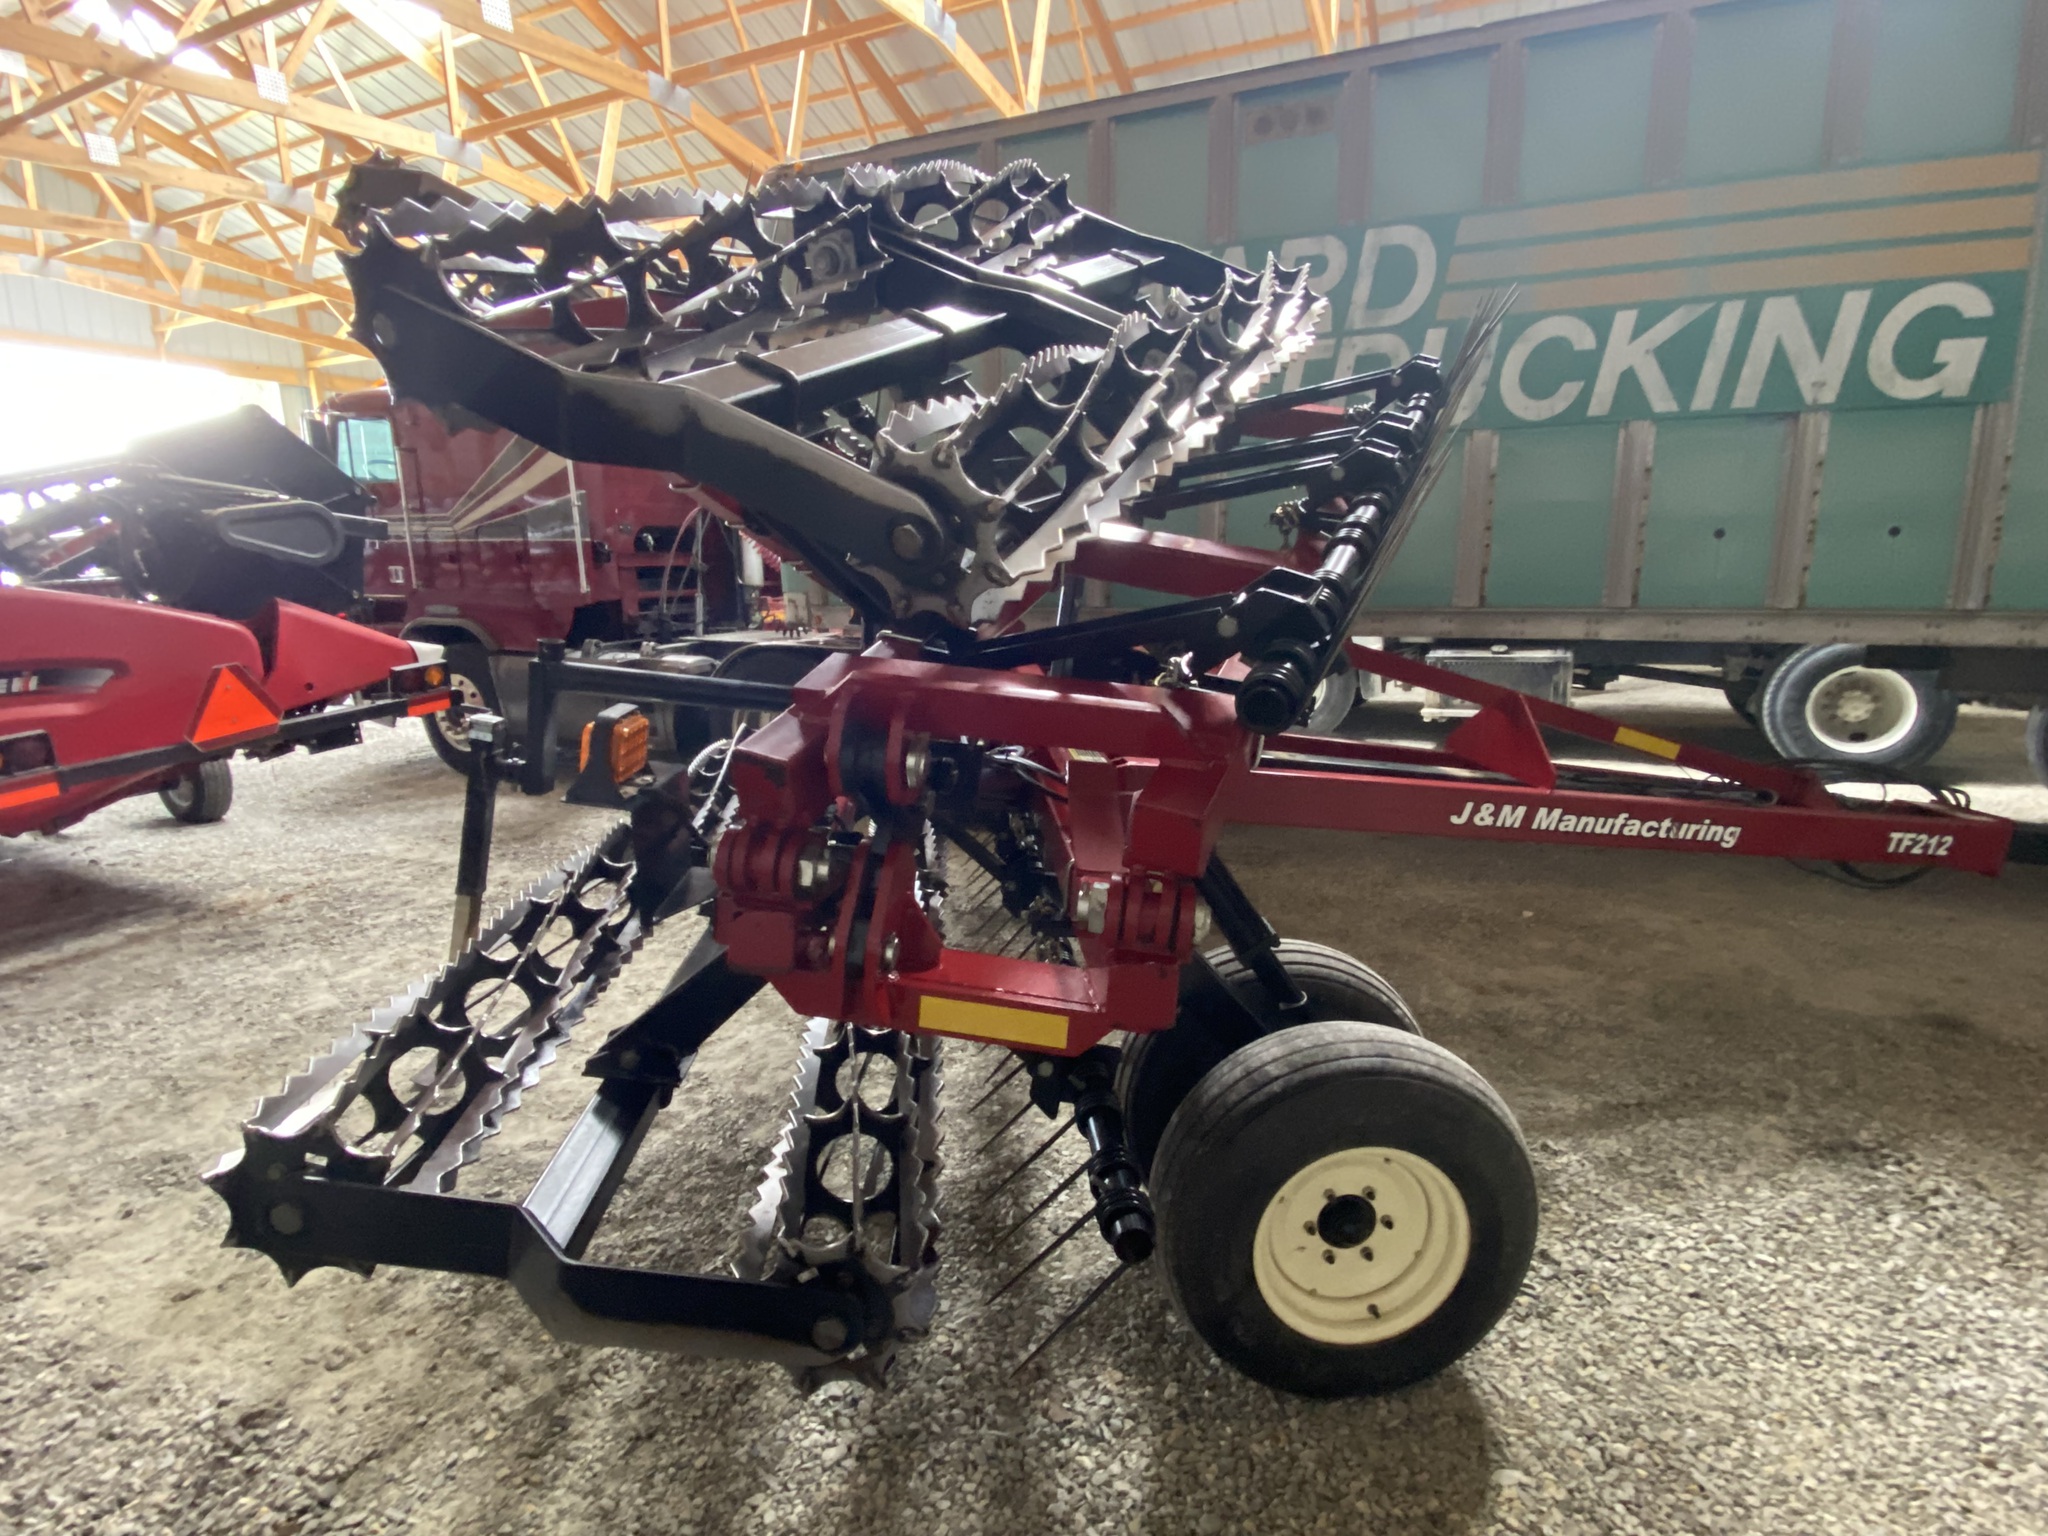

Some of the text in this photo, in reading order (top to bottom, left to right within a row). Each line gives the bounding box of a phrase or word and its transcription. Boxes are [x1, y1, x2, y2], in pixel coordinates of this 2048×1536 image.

[1450, 801, 1742, 849] J&M Manufacturing
[1886, 831, 1954, 856] TF212
